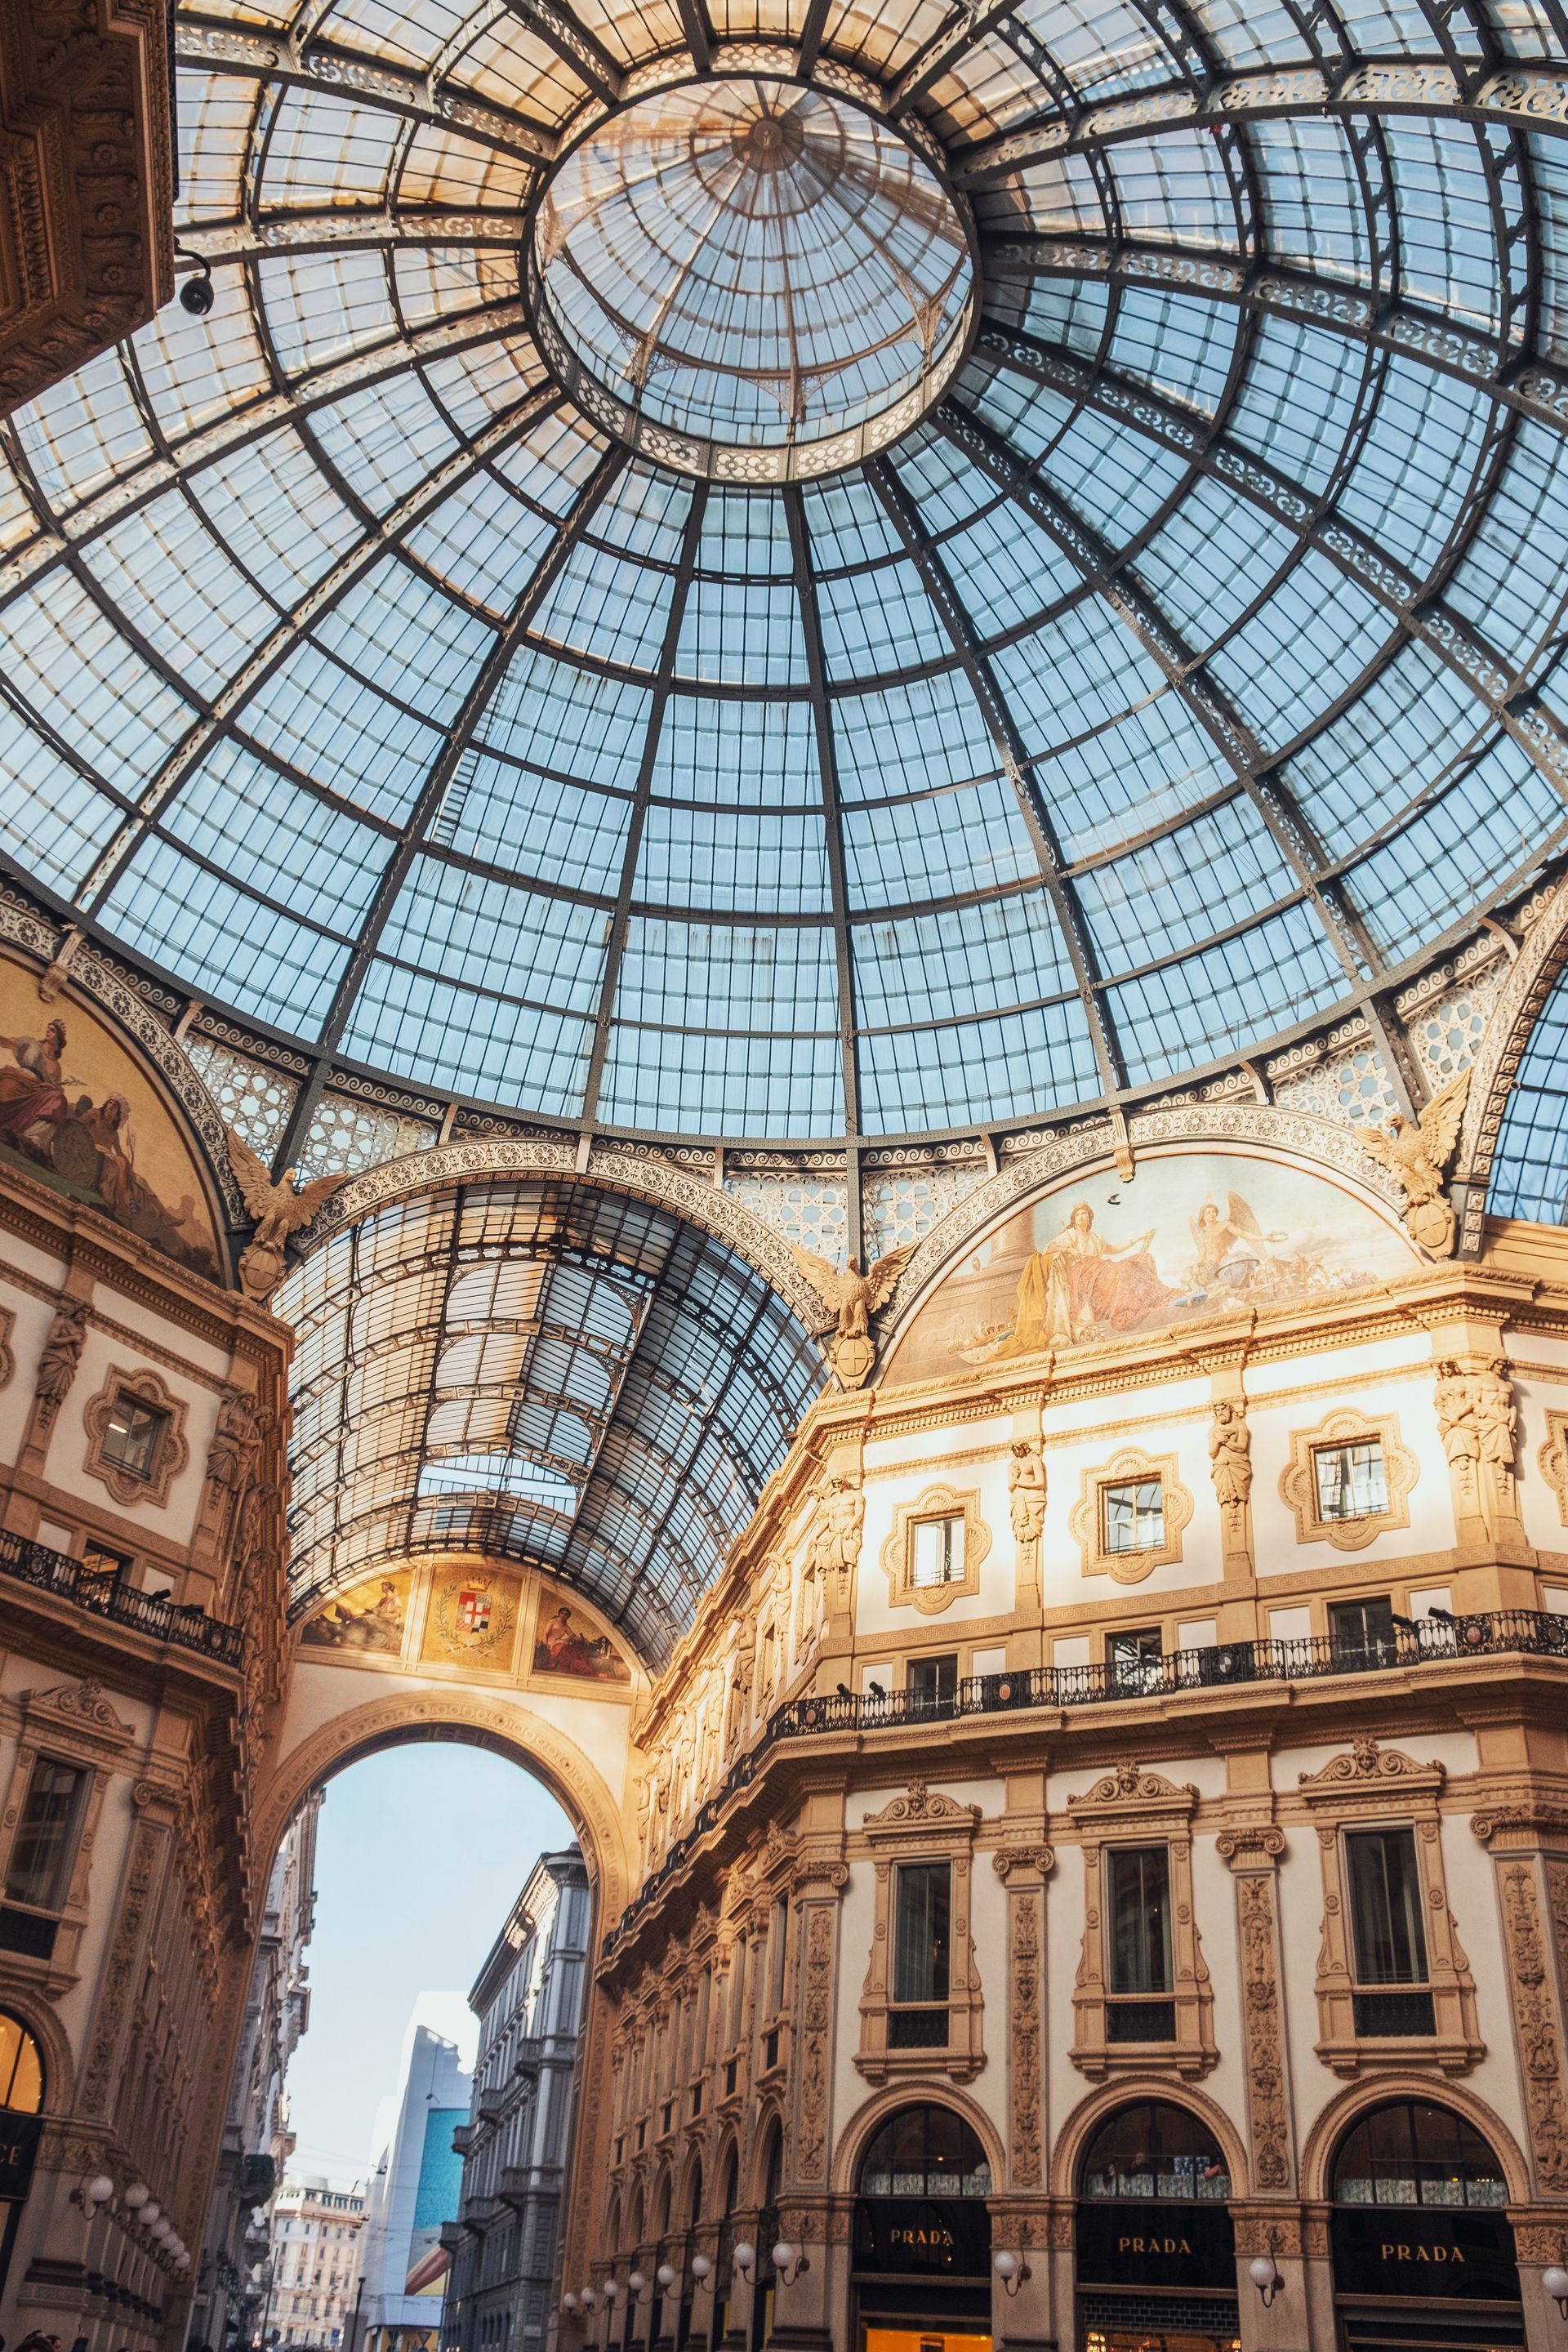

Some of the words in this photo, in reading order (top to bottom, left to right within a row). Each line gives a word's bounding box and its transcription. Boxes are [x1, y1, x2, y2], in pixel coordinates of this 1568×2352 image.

[890, 2230, 954, 2245] PRADA
[1119, 2238, 1192, 2254] PRADA
[1381, 2244, 1466, 2262] PRADA
